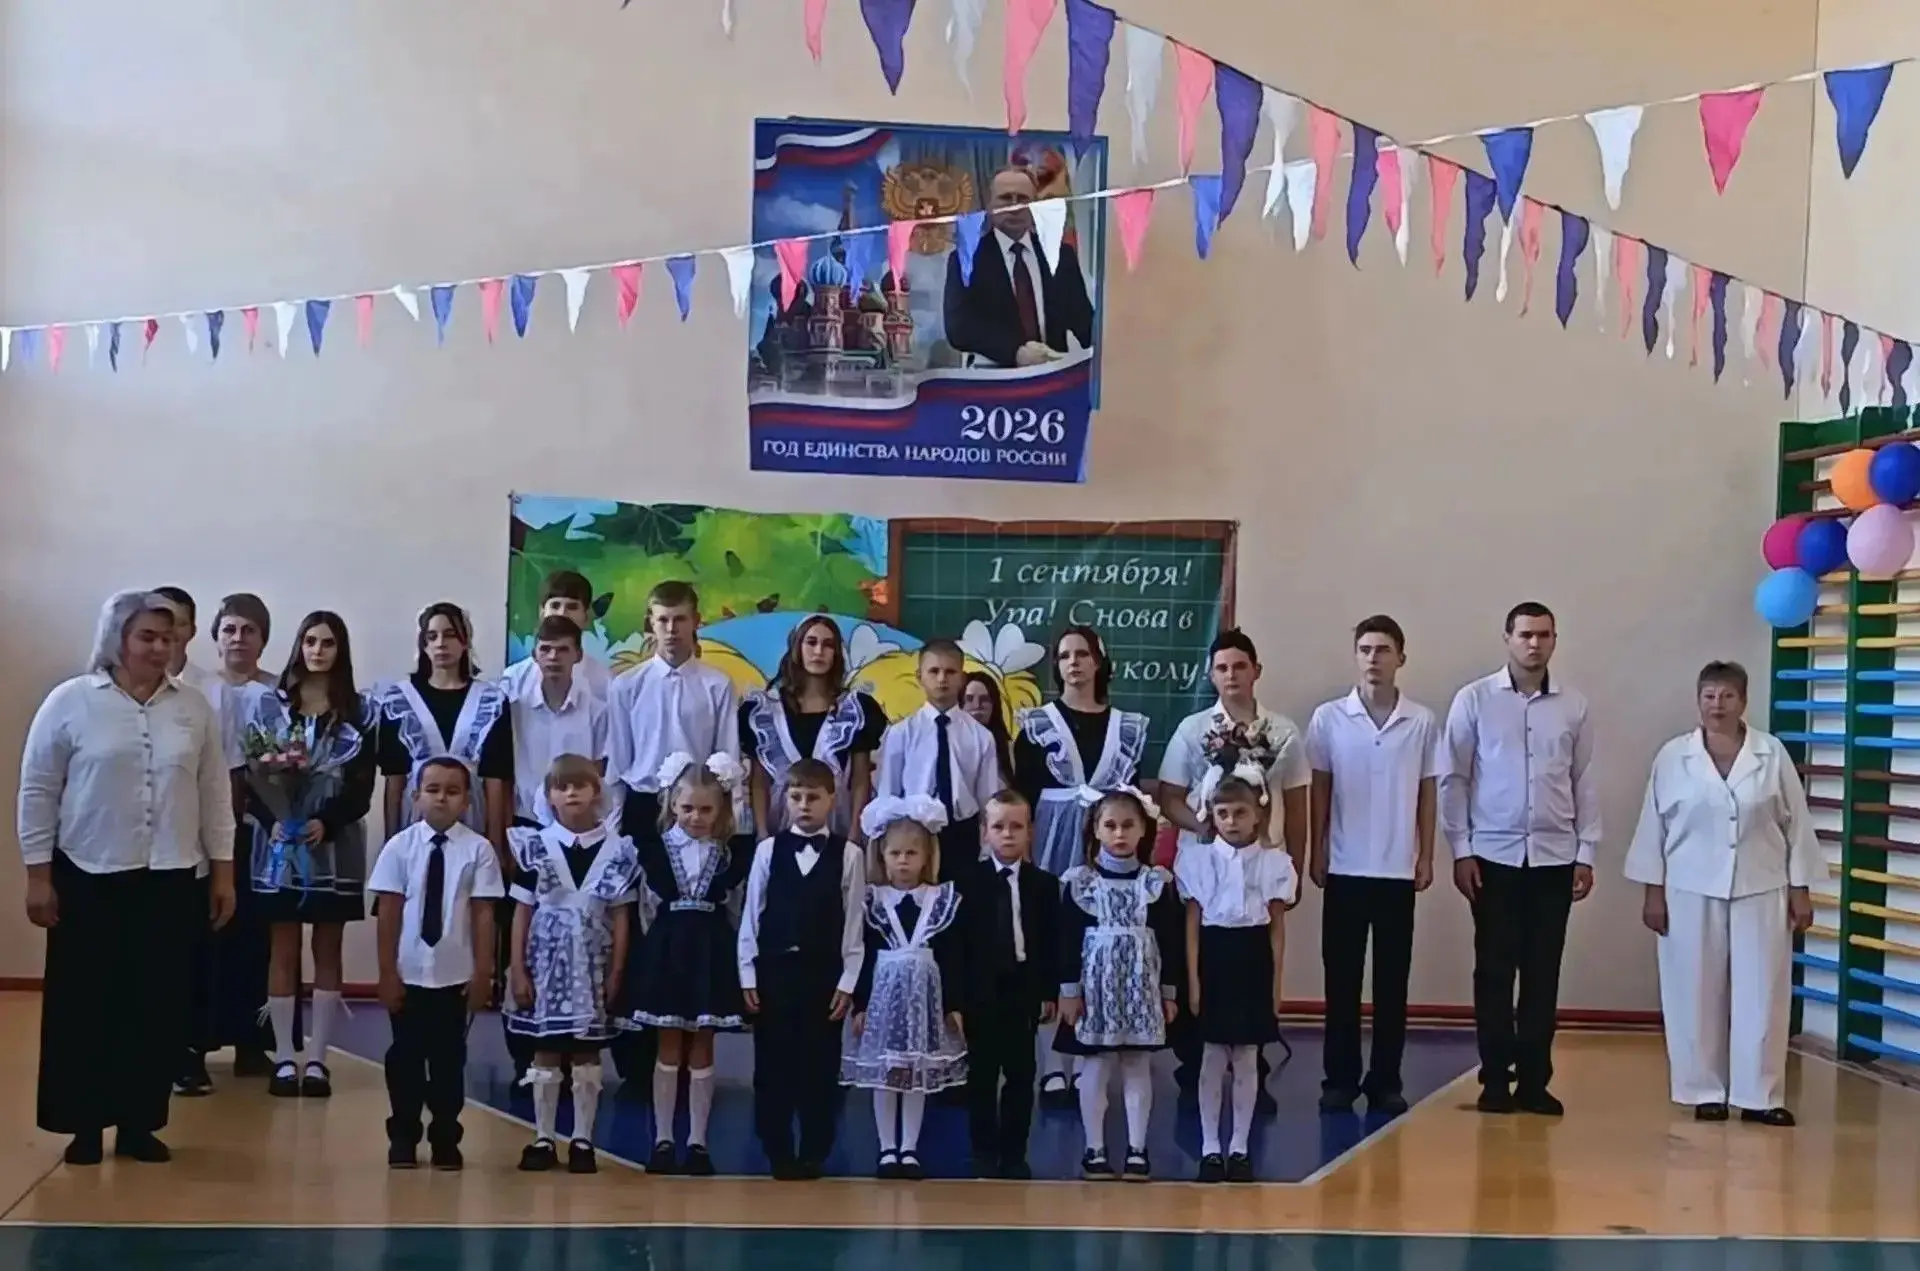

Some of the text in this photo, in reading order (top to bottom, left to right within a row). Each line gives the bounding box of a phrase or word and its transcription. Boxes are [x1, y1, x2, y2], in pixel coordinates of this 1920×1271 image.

[961, 405, 1066, 444] 2026
[762, 439, 1068, 467] ГОД ЕДИНСТВА НАРОДОВ РОССИИ
[989, 556, 1193, 595] 1 сентября!
[1068, 599, 1169, 630] Снова
[1178, 609, 1195, 631] в
[1110, 654, 1210, 691] колу!
